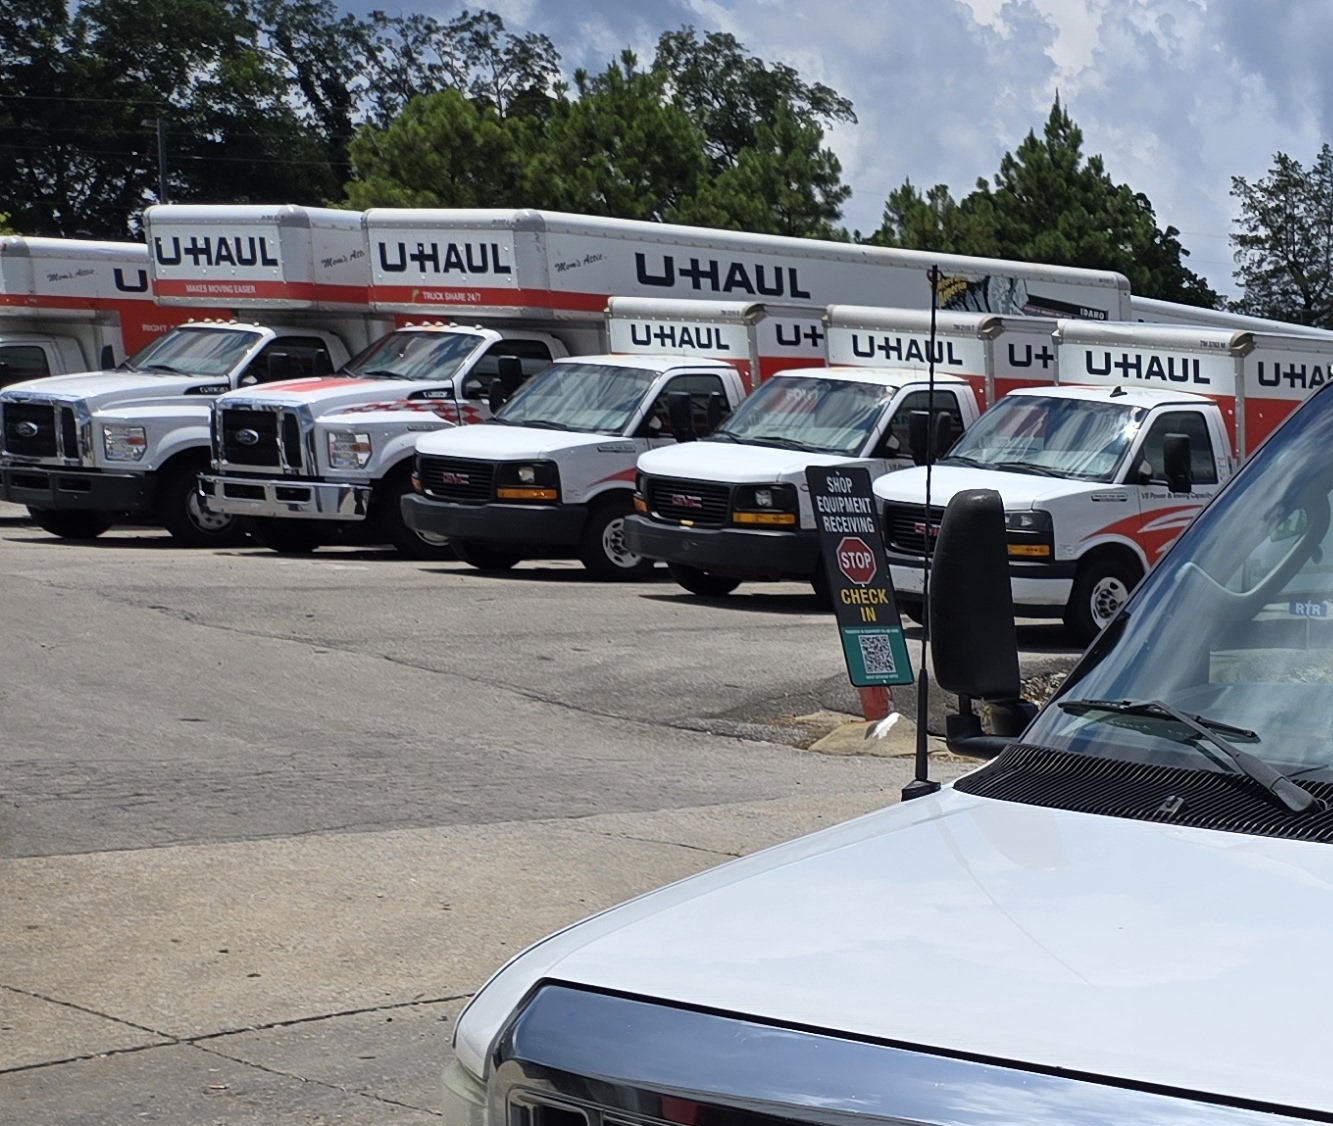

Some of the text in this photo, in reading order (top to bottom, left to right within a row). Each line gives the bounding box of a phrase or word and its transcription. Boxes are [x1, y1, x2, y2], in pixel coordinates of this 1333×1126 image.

[154, 236, 279, 267] U-HAUL
[378, 242, 512, 274] U-HAUL
[635, 252, 811, 299] U-HAUL
[208, 284, 233, 293] MOVING
[631, 323, 730, 350] U-HAUL
[852, 334, 963, 366] U-HAUL
[1085, 350, 1211, 385] U-HAUL
[1258, 361, 1333, 390] U-HA
[826, 476, 853, 494] SHOP
[816, 496, 872, 514] EQUIPMENT
[822, 515, 875, 533] RECEIVING
[841, 551, 872, 570] STOP
[840, 588, 889, 605] CHECK
[860, 607, 877, 622] IN
